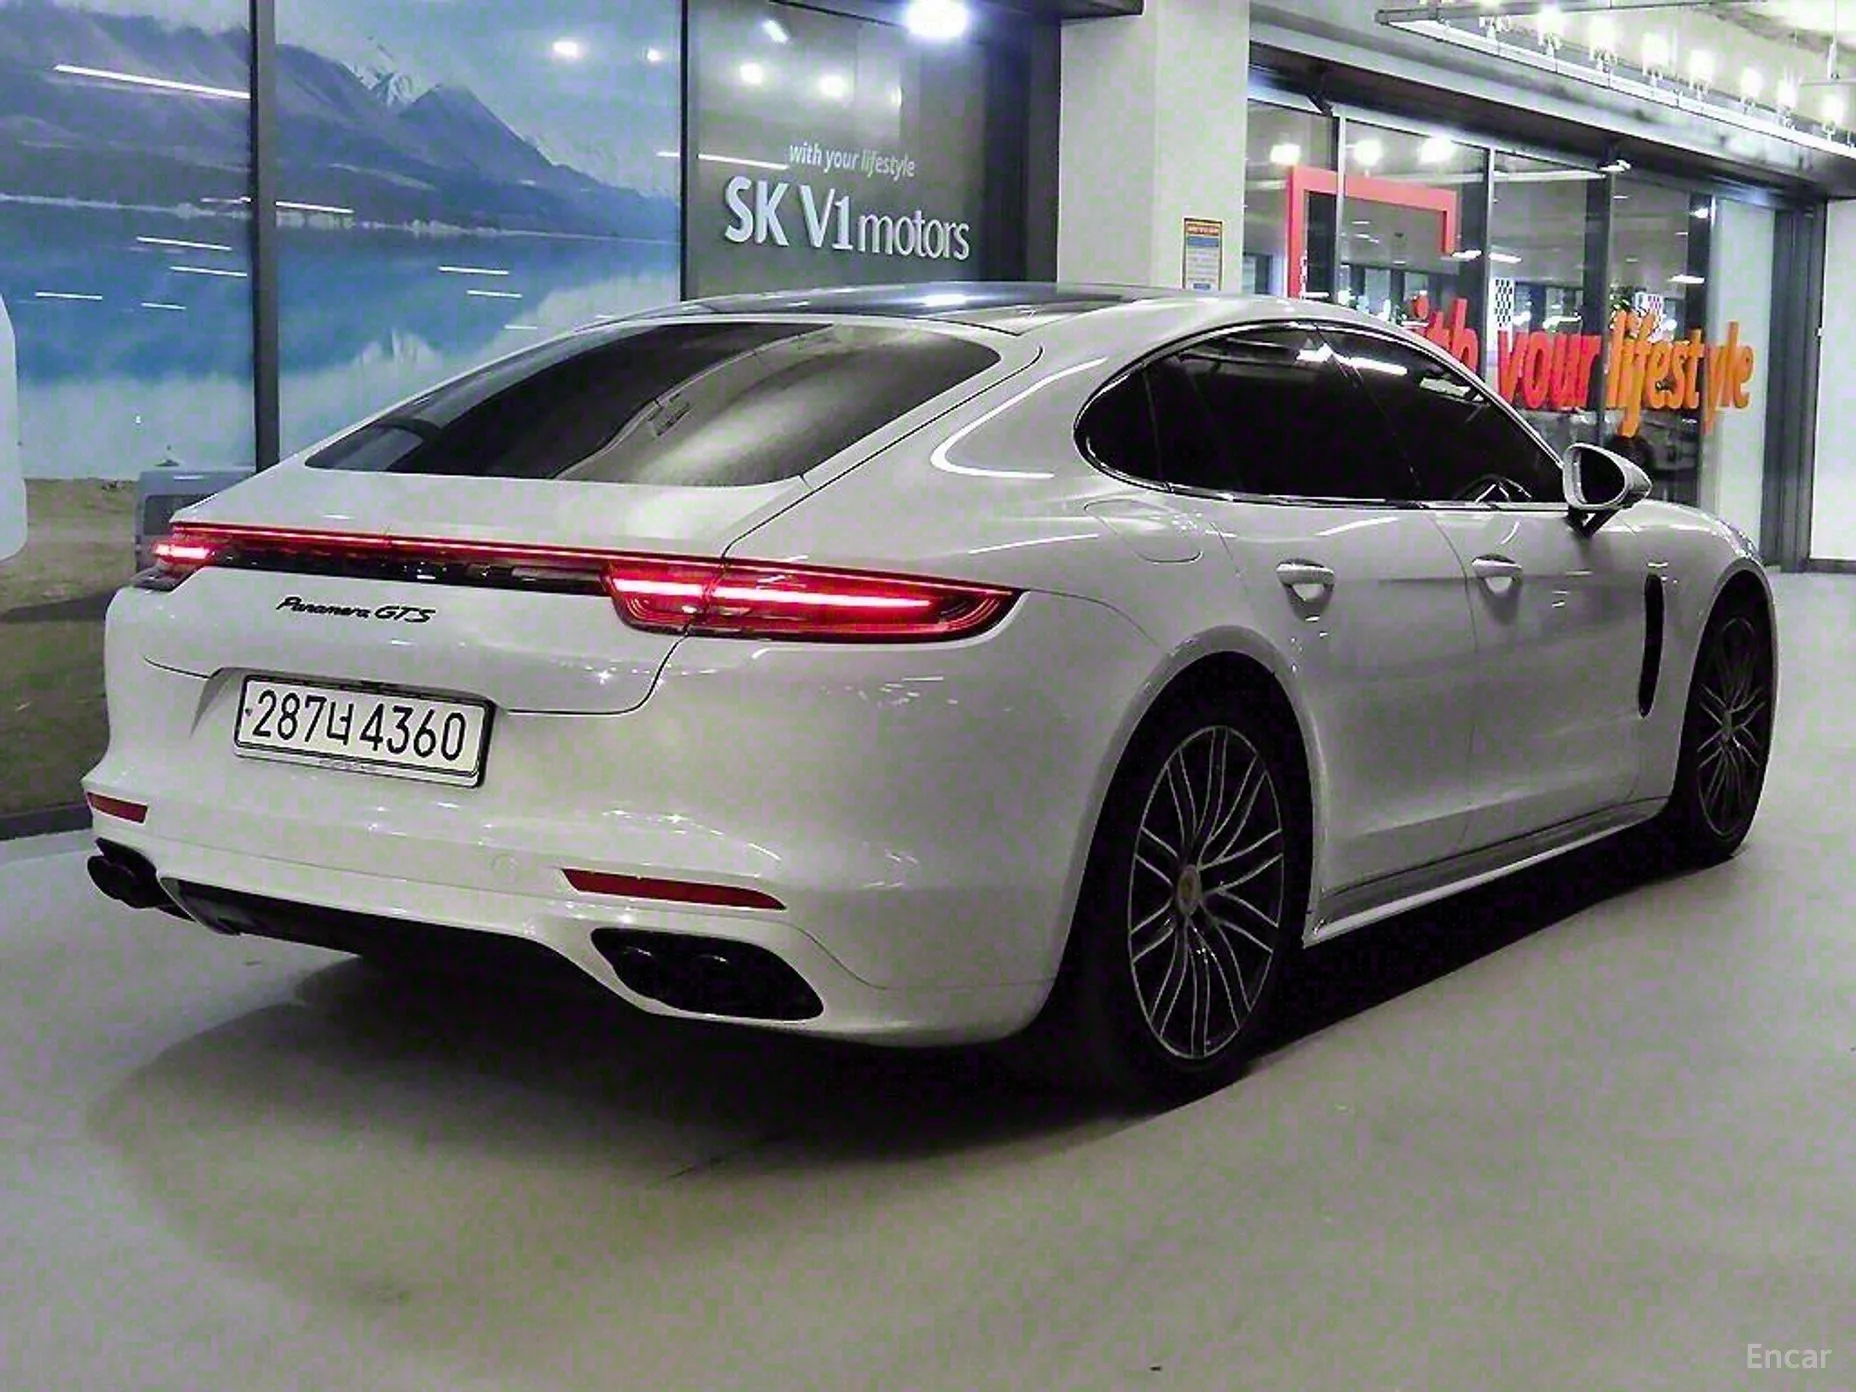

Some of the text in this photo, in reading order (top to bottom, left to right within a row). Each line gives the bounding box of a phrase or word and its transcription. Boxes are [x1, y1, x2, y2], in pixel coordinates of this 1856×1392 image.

[789, 142, 916, 181] with your lifestyle
[724, 175, 970, 261] SK V1 motors
[1604, 307, 1755, 438] lifestyle
[275, 596, 436, 623] Panamera GTS
